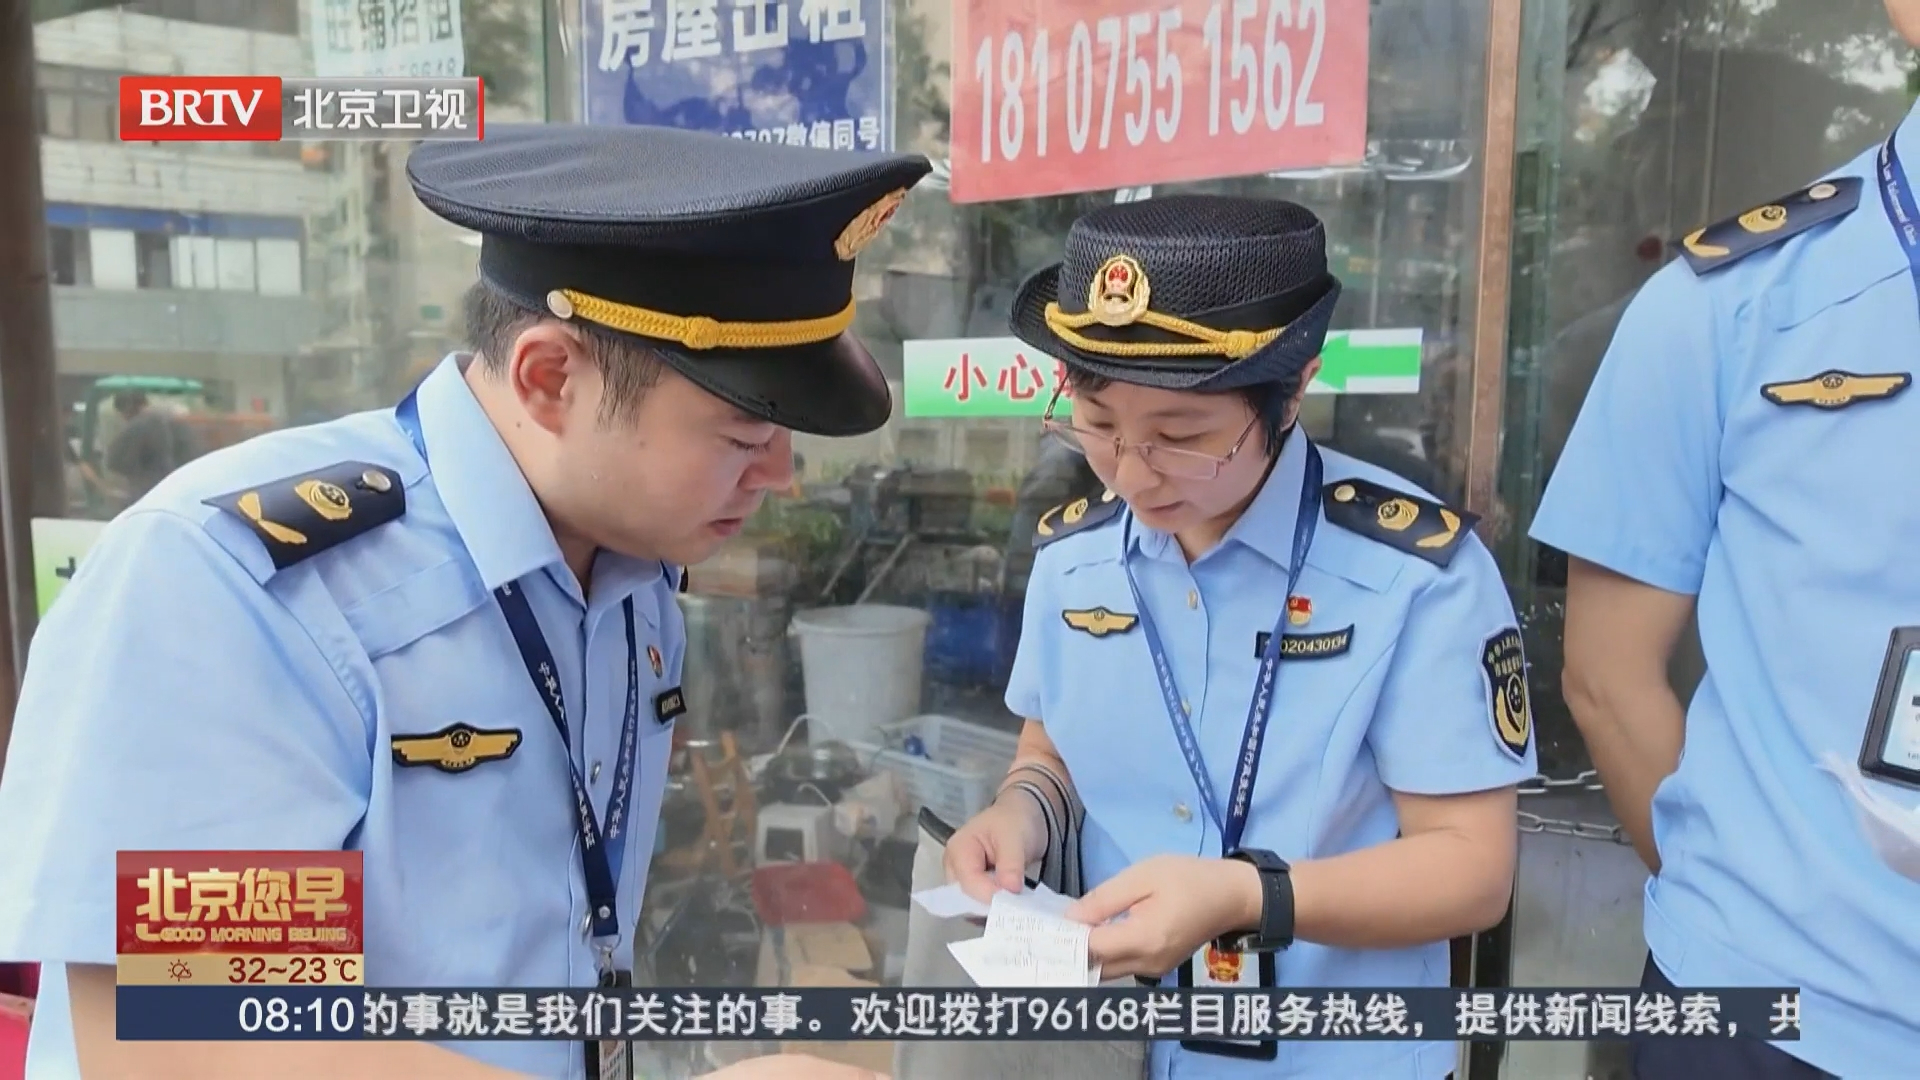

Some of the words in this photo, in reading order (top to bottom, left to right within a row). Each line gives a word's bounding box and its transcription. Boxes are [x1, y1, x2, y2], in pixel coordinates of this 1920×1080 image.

[599, 0, 865, 71] 房屋出租
[976, 28, 1049, 162] 181
[1067, 7, 1182, 154] 0755
[1203, 0, 1325, 136] 1562
[1264, 633, 1349, 655] 020430134
